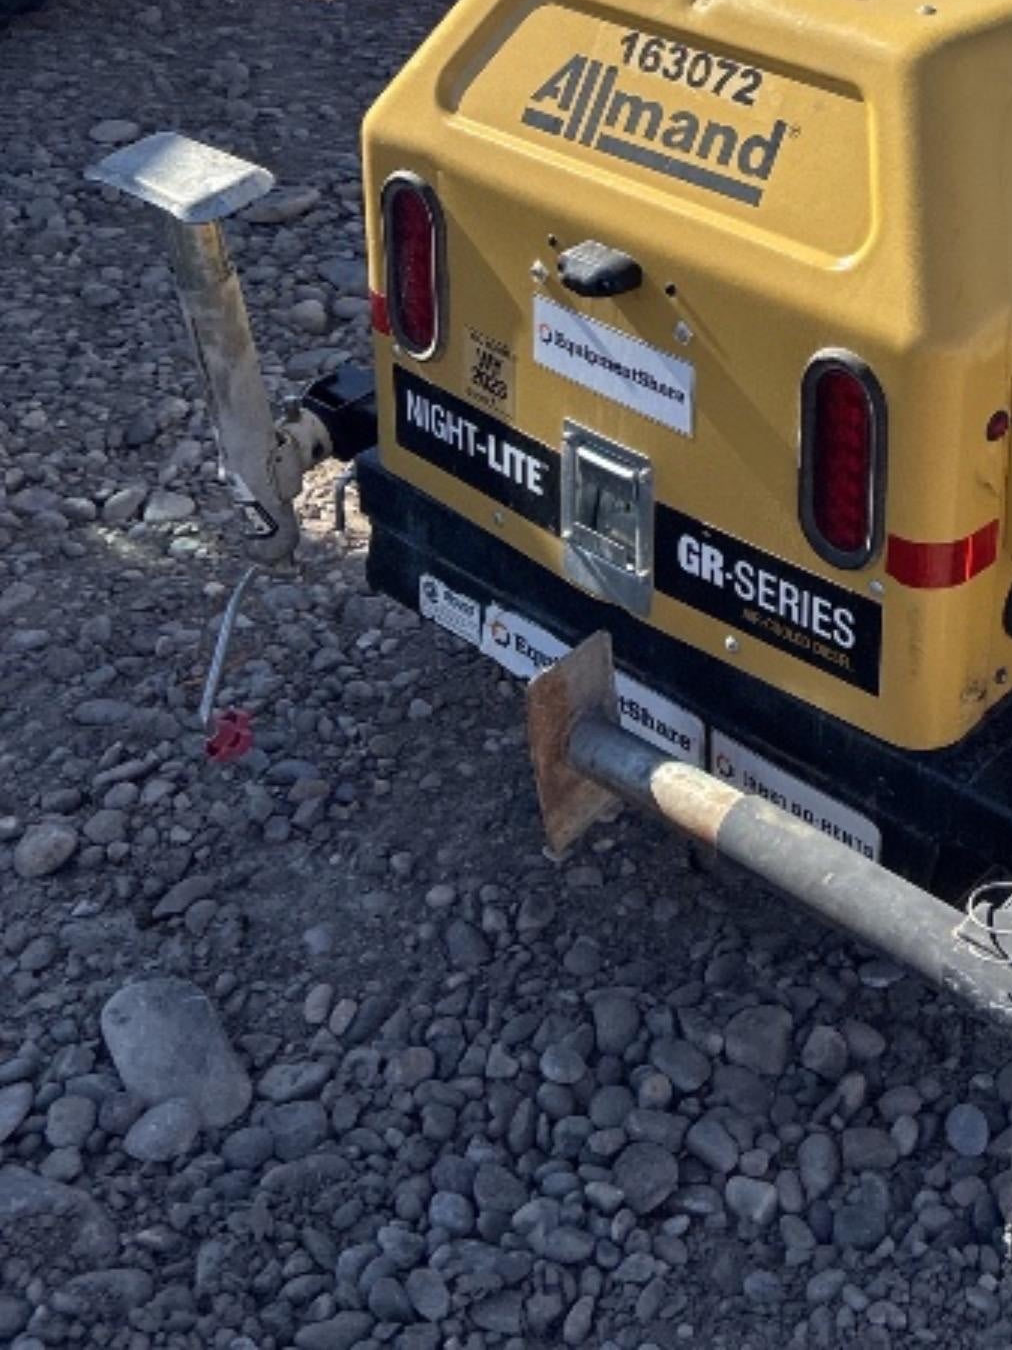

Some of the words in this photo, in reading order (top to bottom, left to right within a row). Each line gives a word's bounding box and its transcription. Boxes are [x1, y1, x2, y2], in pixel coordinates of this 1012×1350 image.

[525, 53, 787, 181] Allmand
[620, 30, 764, 106] 163072
[553, 328, 685, 405] EquipmentShare
[406, 389, 544, 496] NIGHT-LITE
[676, 533, 856, 649] GR-SERIES
